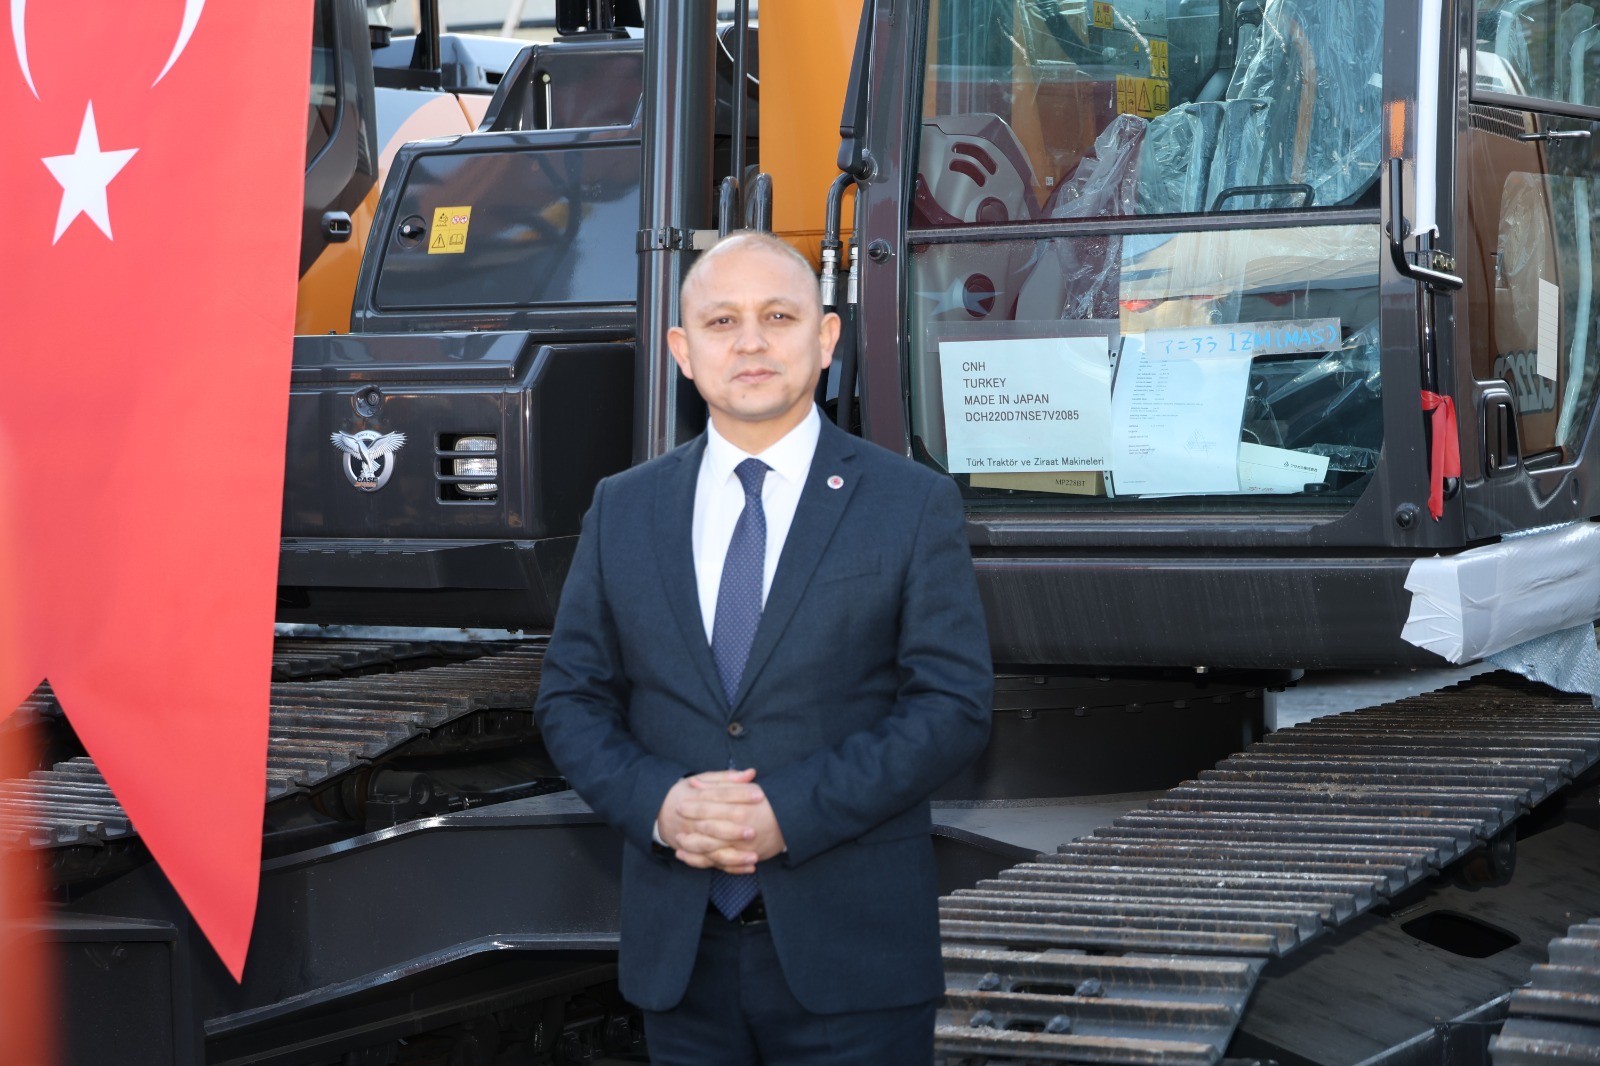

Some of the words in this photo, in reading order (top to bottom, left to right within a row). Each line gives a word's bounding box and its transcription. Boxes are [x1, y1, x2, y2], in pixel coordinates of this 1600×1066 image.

[962, 361, 986, 372] CNH
[963, 378, 1007, 388] TURKEY
[964, 395, 995, 405] MADE
[998, 394, 1010, 404] IN
[1013, 393, 1050, 405] JAPAN
[965, 410, 1080, 422] DCH220D7NSE7V2085
[966, 457, 985, 467] Türk
[987, 457, 1019, 466] Traktör
[1034, 457, 1059, 466] Ziraat
[1061, 456, 1105, 466] Makineleri
